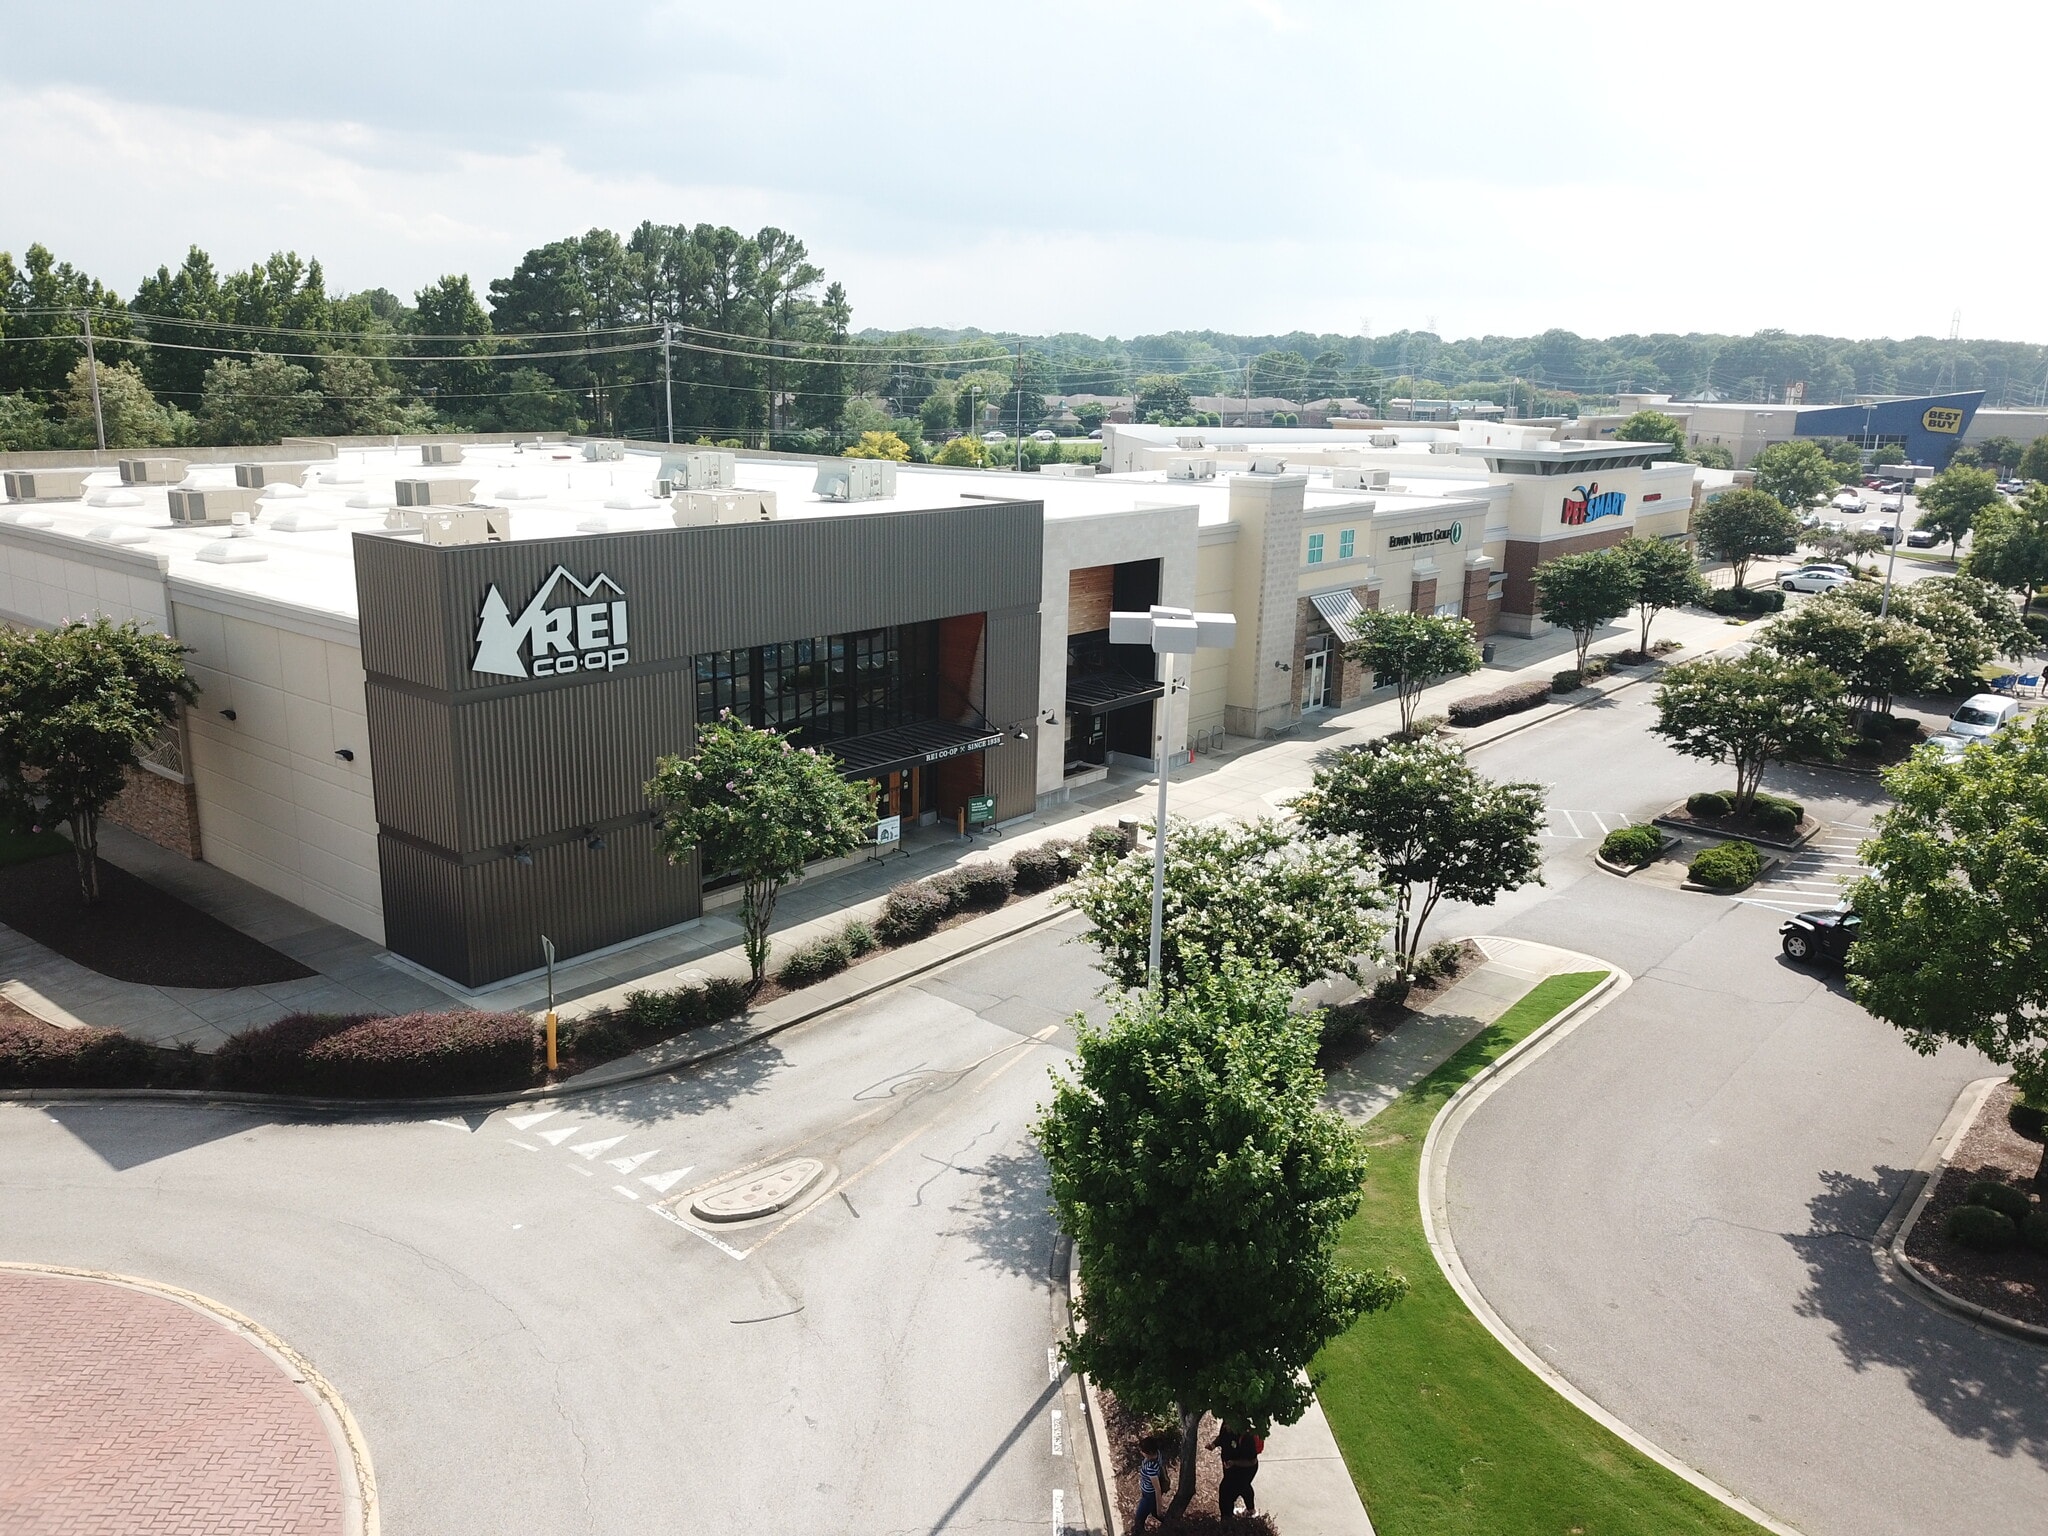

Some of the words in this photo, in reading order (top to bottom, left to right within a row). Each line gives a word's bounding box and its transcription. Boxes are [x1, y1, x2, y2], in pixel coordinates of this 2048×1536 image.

[1928, 420, 1955, 429] BUY
[1929, 411, 1960, 420] BEST
[1561, 491, 1627, 525] PETSMART
[531, 600, 628, 657] REI
[926, 753, 938, 761] REI
[938, 747, 958, 758] CO-OP
[967, 740, 987, 751] SINCE
